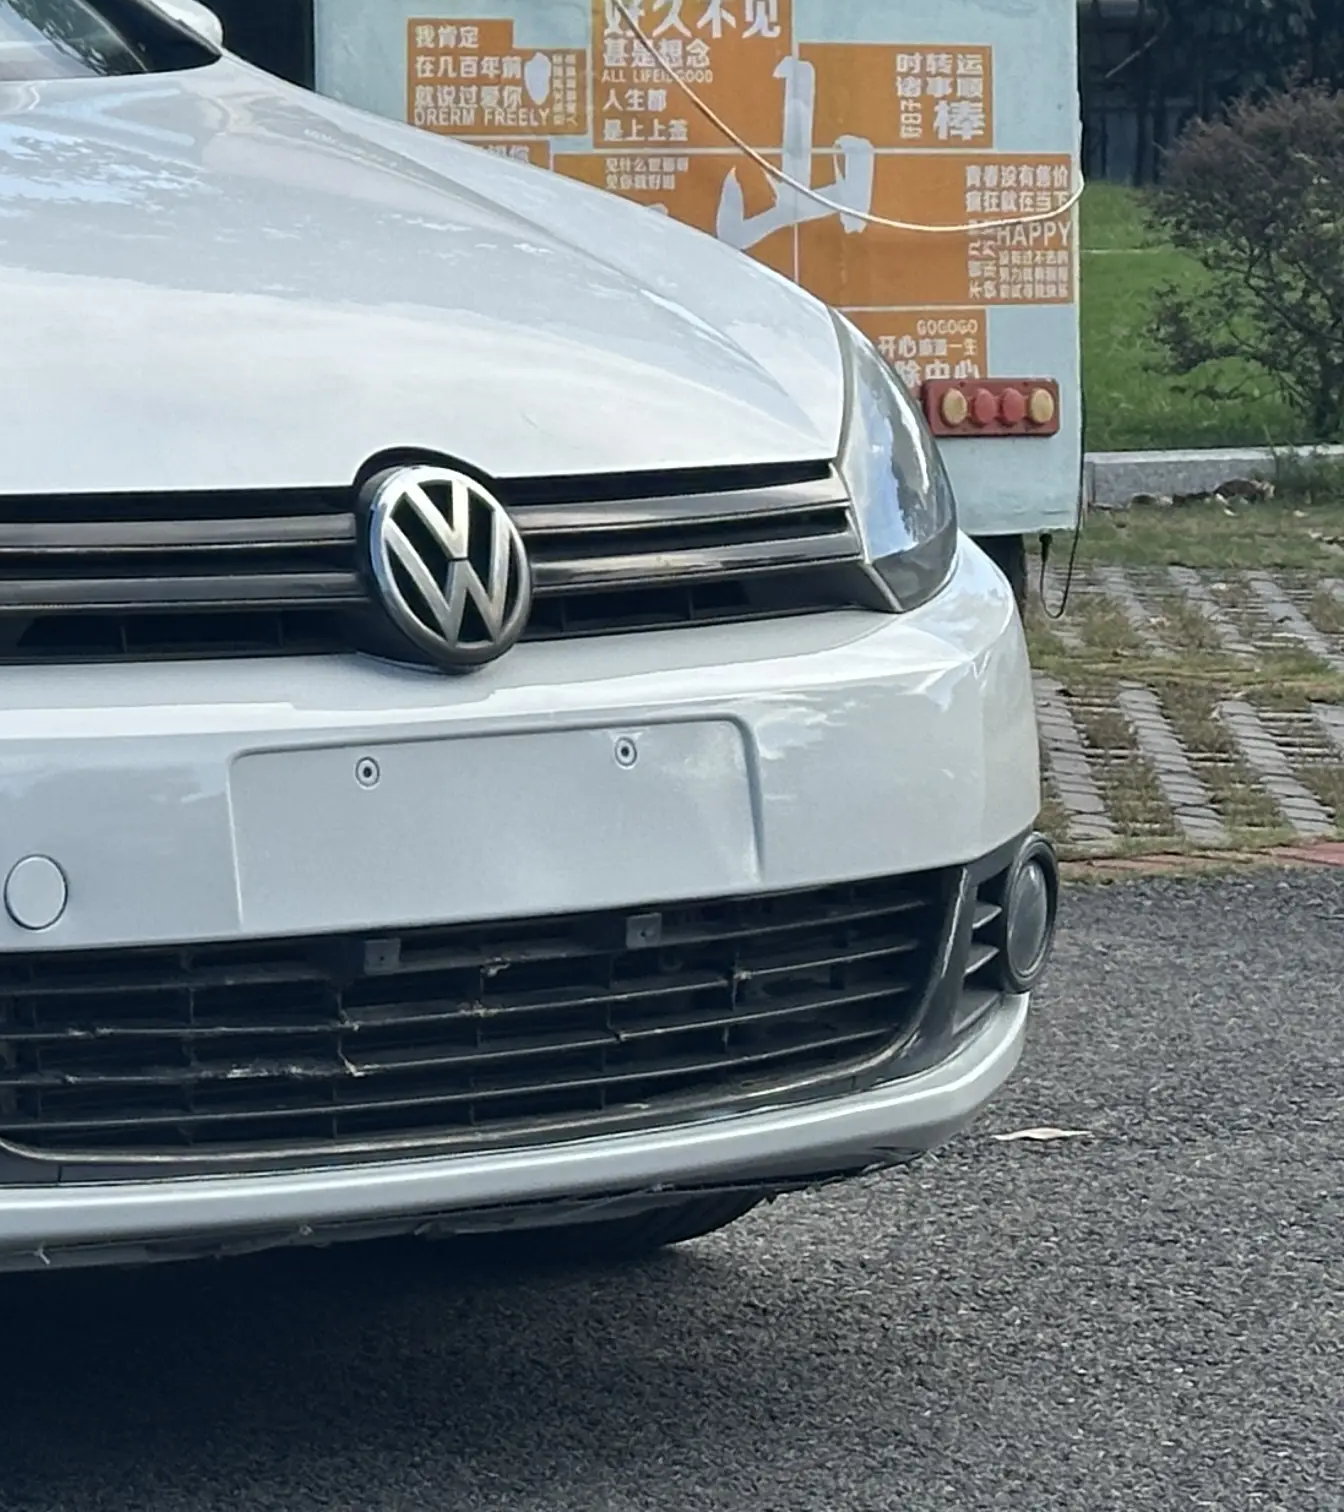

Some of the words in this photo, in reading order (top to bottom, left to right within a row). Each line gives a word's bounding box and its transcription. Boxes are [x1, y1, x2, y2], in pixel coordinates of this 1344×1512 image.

[415, 24, 479, 49] 我肯定
[603, 38, 710, 68] 甚是想念
[415, 55, 523, 79] 在几百年前
[601, 69, 627, 84] ALL
[603, 88, 667, 112] 人生都
[484, 107, 550, 126] FREELY
[933, 100, 985, 141] 棒
[603, 119, 688, 141] 是上上签
[996, 220, 1071, 247] HAPPY
[382, 476, 512, 646] VW
